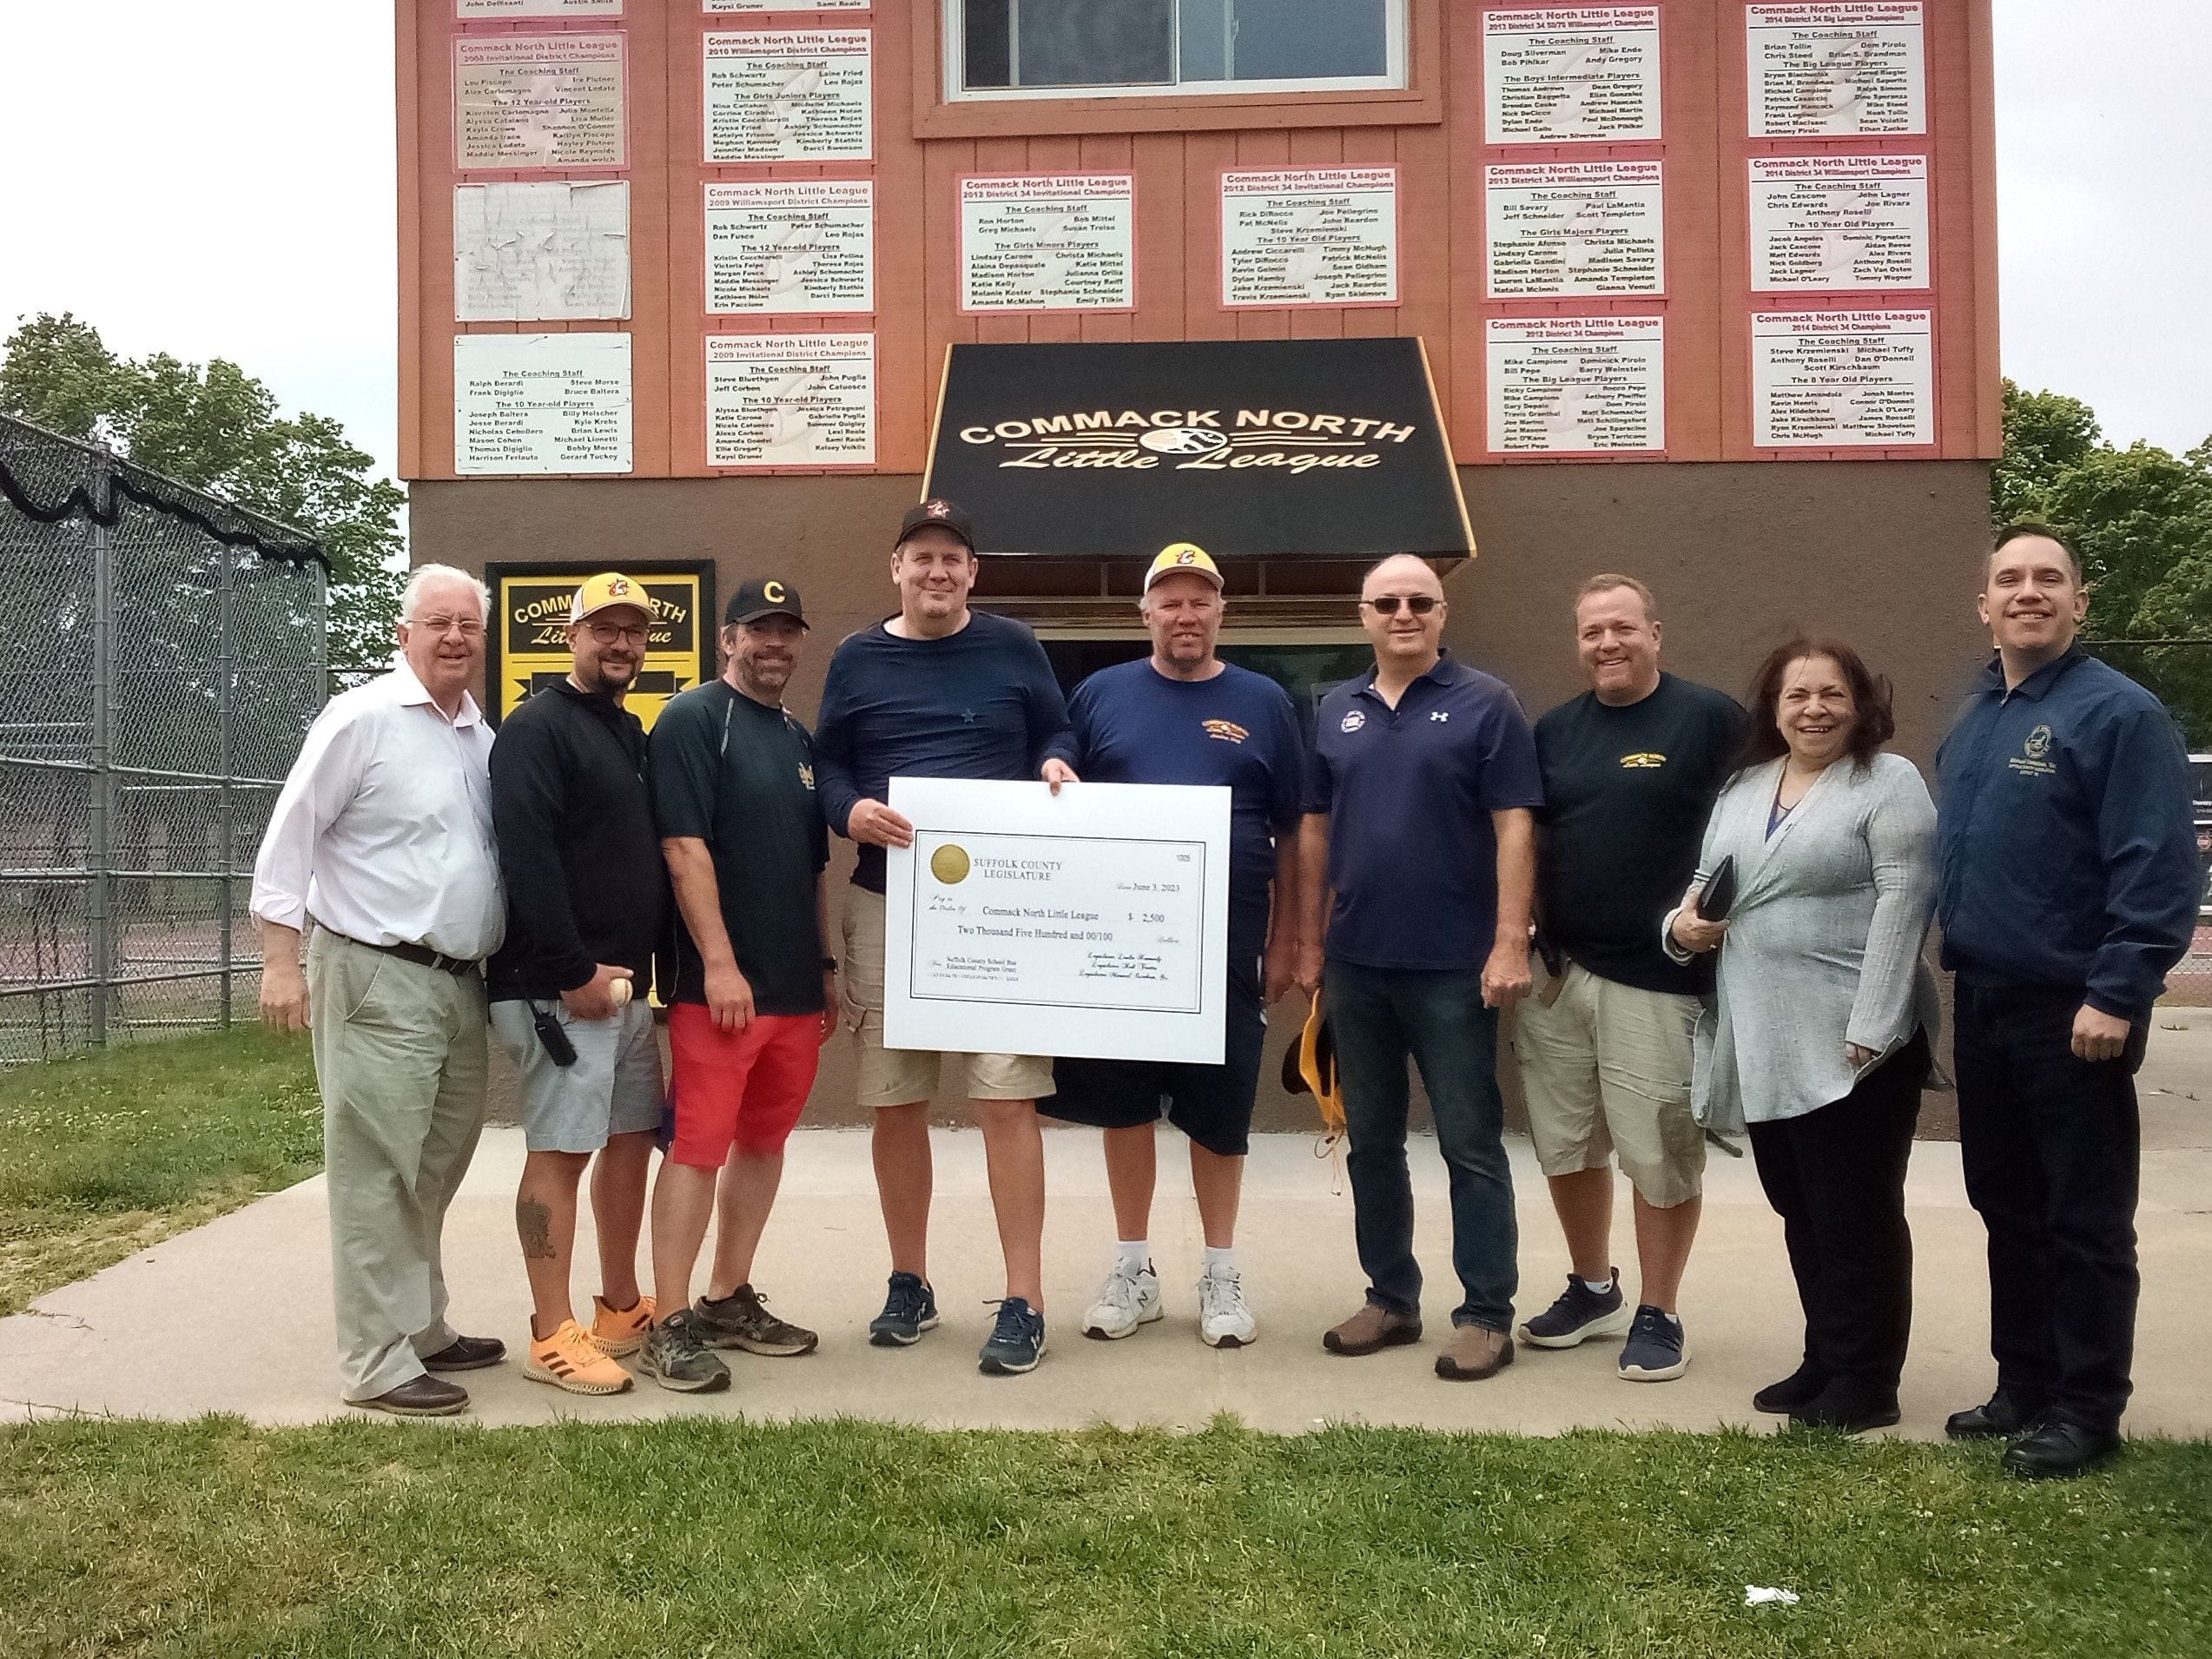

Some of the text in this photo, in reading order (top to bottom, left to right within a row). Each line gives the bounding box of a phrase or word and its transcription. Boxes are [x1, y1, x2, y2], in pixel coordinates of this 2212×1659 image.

[1752, 6, 1806, 15] Commack
[1878, 4, 1918, 13] League
[1547, 11, 1577, 20] North
[1614, 10, 1654, 19] League
[829, 36, 867, 44] League
[461, 44, 512, 53] Commack
[515, 43, 545, 51] North
[579, 42, 617, 50] League
[1881, 158, 1922, 167] League
[1617, 164, 1657, 173] League
[1350, 171, 1390, 180] League
[1088, 178, 1127, 188] League
[829, 187, 868, 195] League
[1757, 314, 1813, 323] Commack
[1885, 313, 1925, 321] League
[1618, 320, 1658, 328] League
[830, 339, 868, 347] League
[960, 410, 1416, 444] COMMACK NORTH
[999, 447, 1380, 473] Little League
[764, 581, 785, 603] C
[515, 595, 572, 623] COMM
[650, 598, 686, 623] RTH
[531, 626, 569, 644] Lit
[974, 858, 1062, 869] SUFFOLK COUNTY
[985, 870, 1051, 880] LEGISLATURE
[983, 907, 1099, 922] Commack North Little League
[1143, 914, 1165, 922] 2,500
[958, 925, 974, 934] Two
[977, 927, 1013, 936] Thousand
[1016, 929, 1032, 937] Five
[1035, 929, 1067, 939] Hundred
[1086, 932, 1113, 942] 00/100
